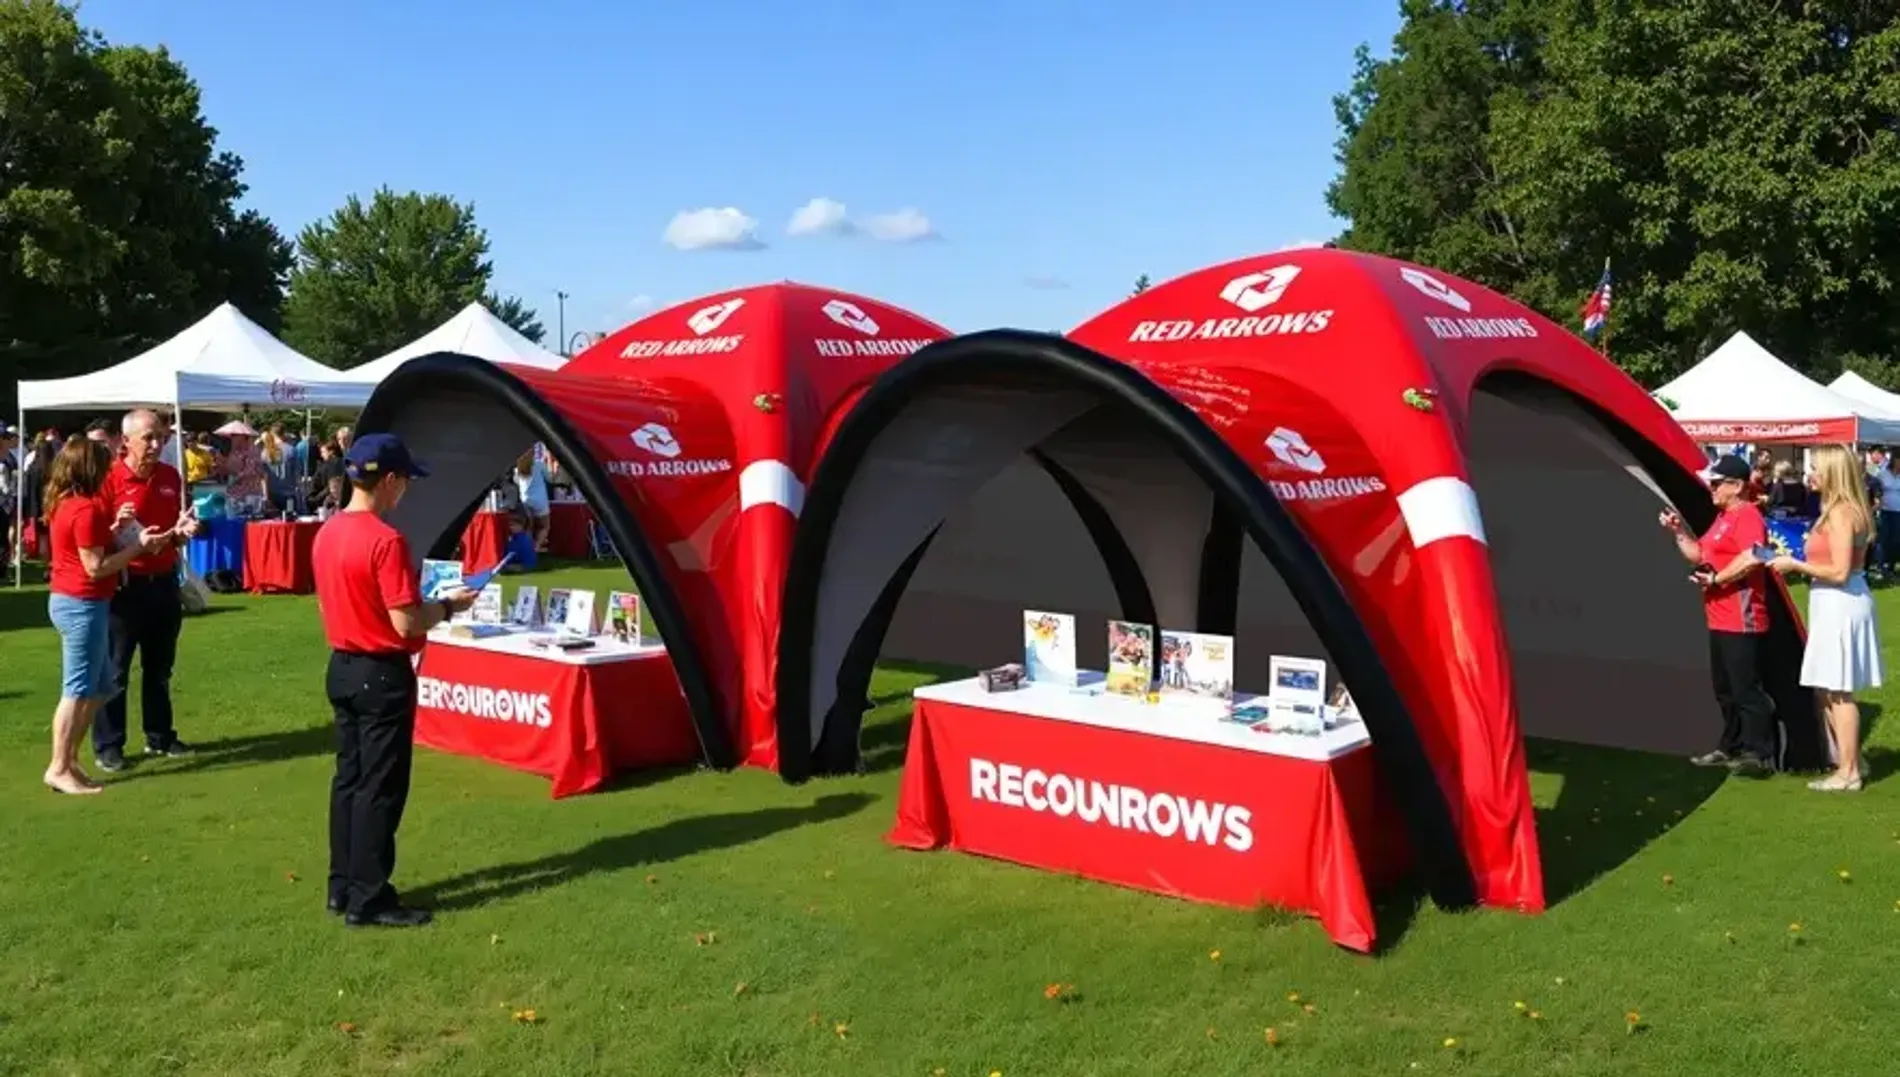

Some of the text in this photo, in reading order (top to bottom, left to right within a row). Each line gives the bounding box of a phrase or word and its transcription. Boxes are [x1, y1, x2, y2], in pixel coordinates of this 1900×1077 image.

[1128, 309, 1334, 342] RED ARROWS
[1424, 316, 1538, 338] RED ARROWS
[620, 334, 744, 359] RED ARROWS
[814, 338, 853, 356] RED
[1268, 476, 1386, 500] ED ARROWS
[969, 757, 1254, 852] RECOUNROWS
